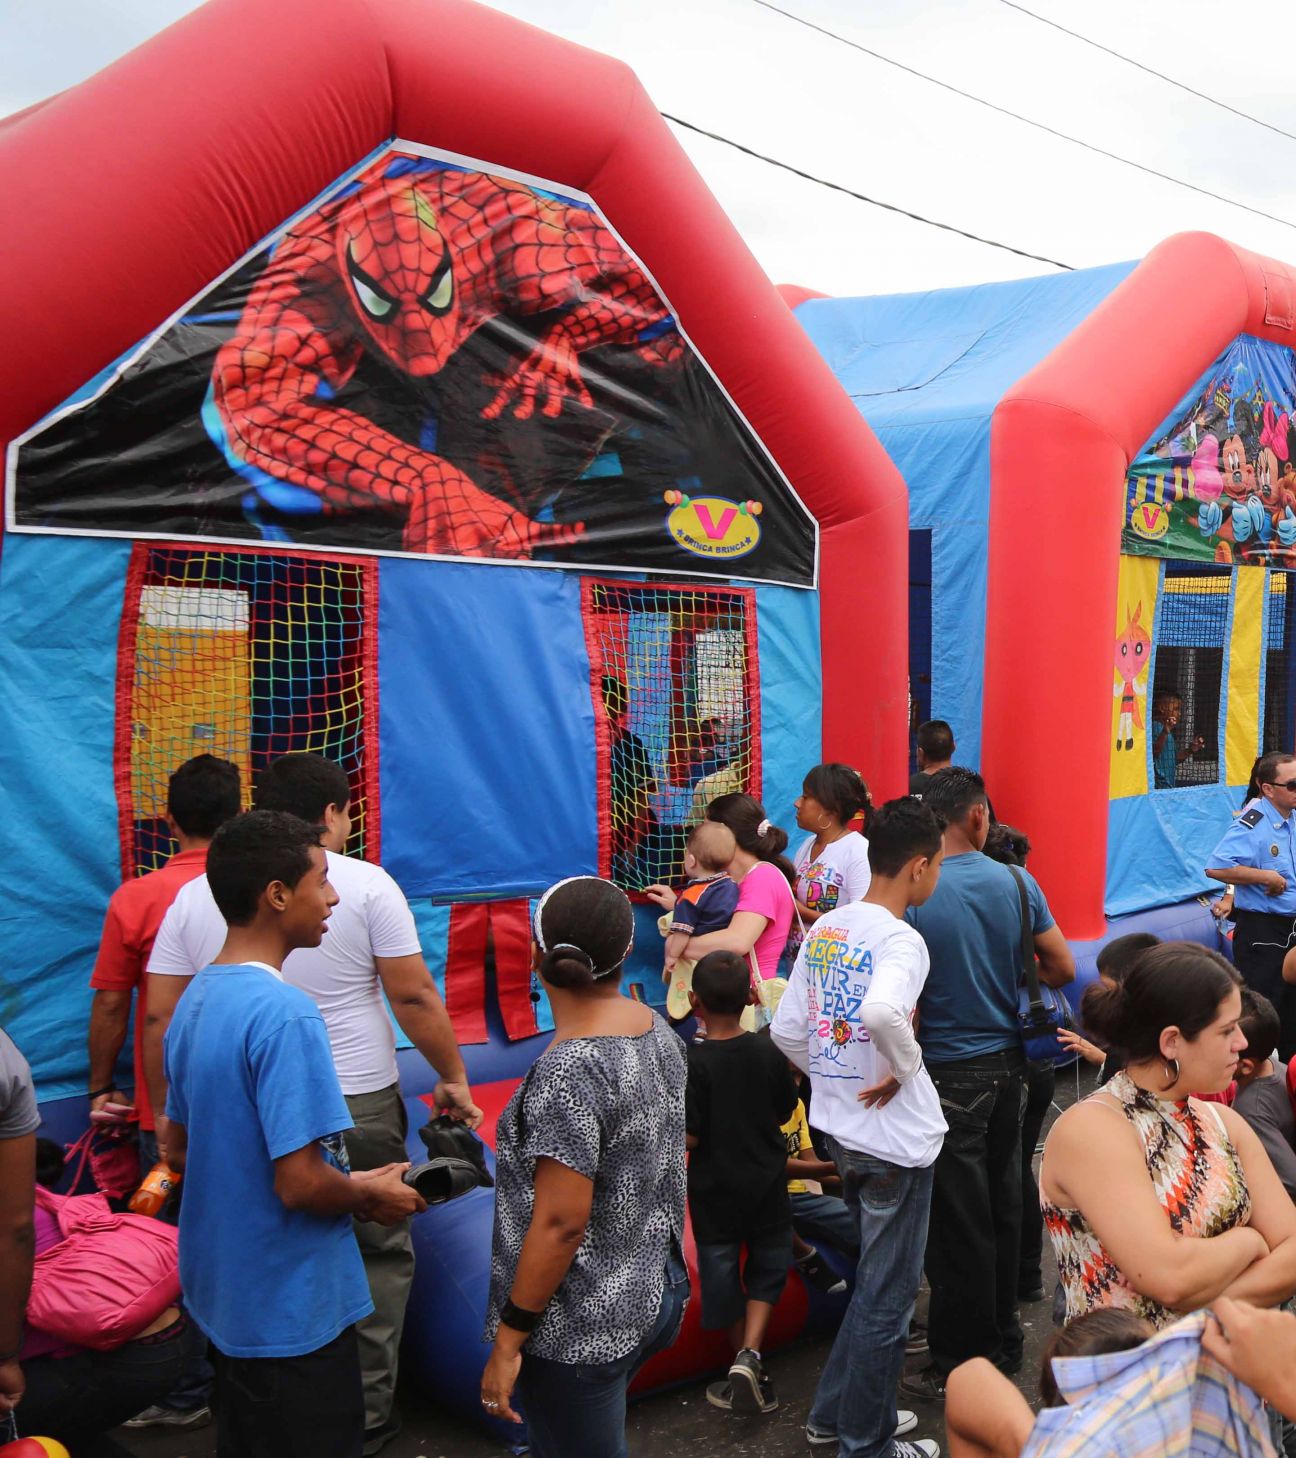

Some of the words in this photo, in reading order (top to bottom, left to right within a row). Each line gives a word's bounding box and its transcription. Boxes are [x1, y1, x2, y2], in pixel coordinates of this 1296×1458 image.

[693, 504, 738, 540] V
[1142, 507, 1161, 529] V
[683, 533, 713, 553] BRINCA
[715, 542, 746, 554] BRINCA
[821, 991, 863, 1023] PAZ
